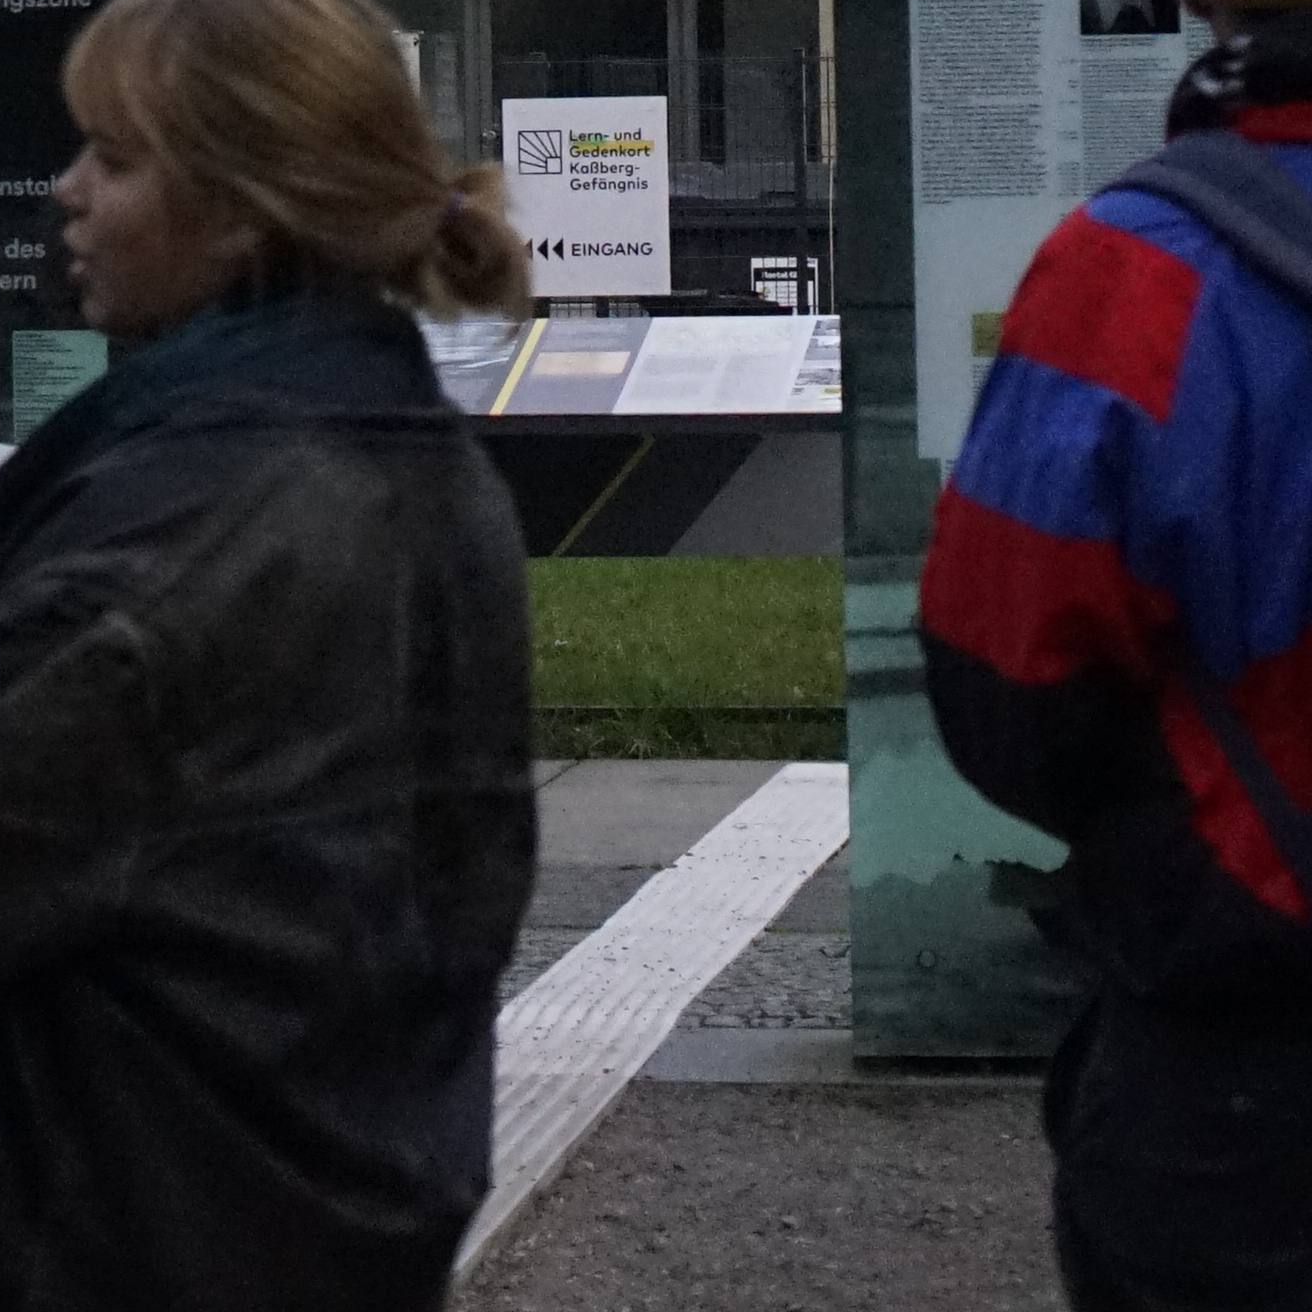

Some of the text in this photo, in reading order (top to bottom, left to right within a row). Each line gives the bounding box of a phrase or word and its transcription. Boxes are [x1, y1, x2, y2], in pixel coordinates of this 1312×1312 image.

[569, 128, 642, 142] Lern- und
[569, 144, 651, 158] Gedenkort
[569, 162, 641, 177] Kaßberg-
[569, 177, 649, 193] Gefängnis
[4, 237, 47, 260] des
[571, 241, 654, 257] EINGANG
